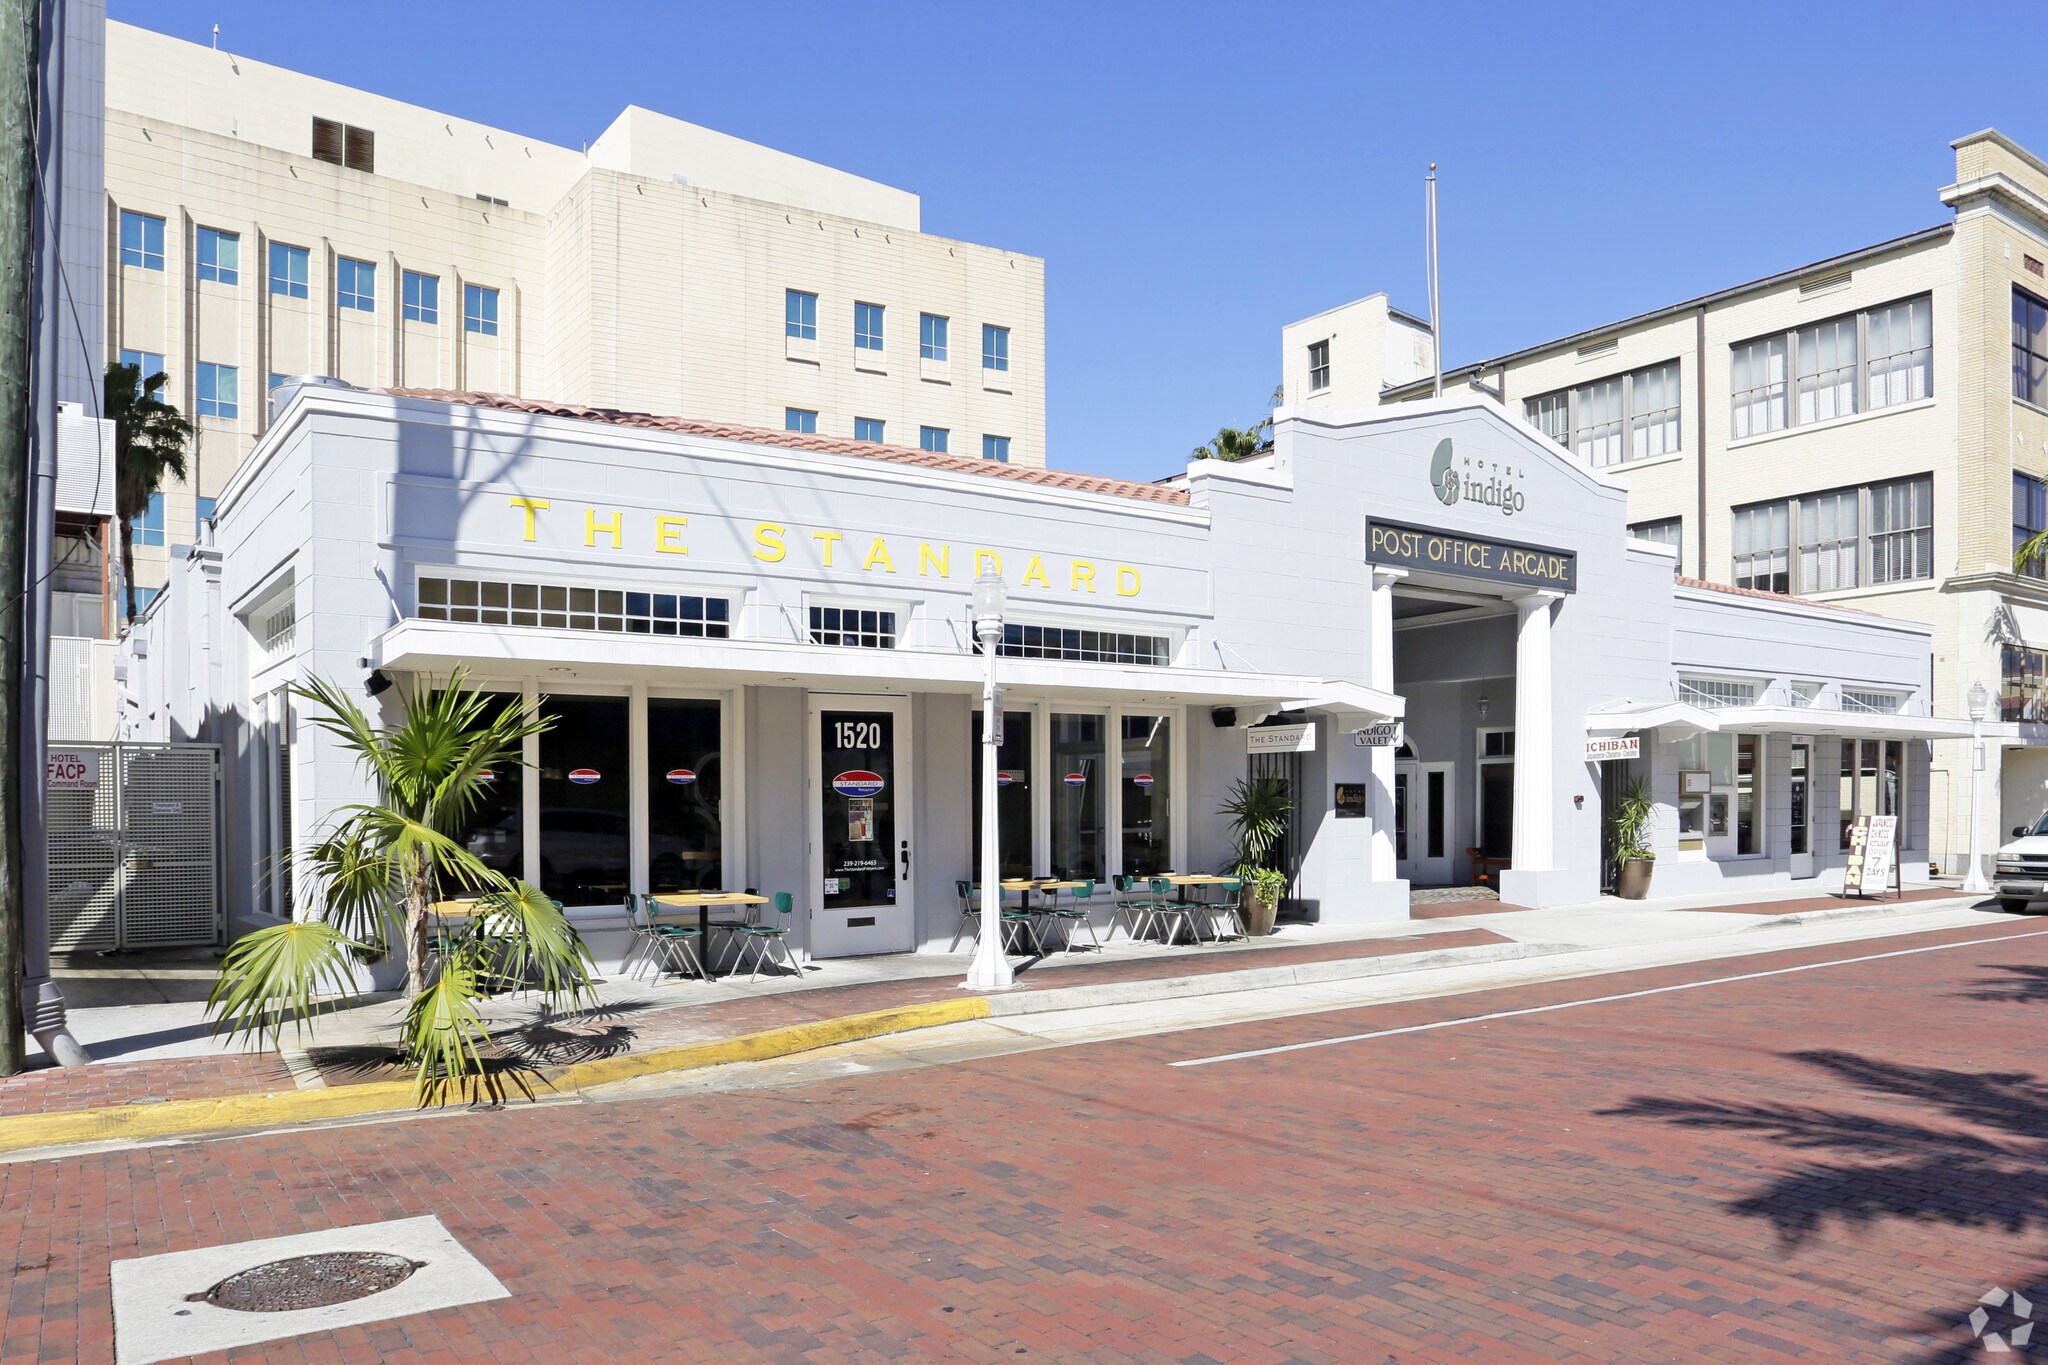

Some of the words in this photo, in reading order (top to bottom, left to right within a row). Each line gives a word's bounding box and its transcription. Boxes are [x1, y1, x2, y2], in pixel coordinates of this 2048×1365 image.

[1464, 457, 1524, 478] HOTEL
[1463, 472, 1525, 516] indigo
[510, 497, 688, 555] THE
[753, 522, 1142, 597] STANDARD
[1371, 528, 1423, 558] POST
[1427, 537, 1492, 569] OFFICE
[1499, 550, 1569, 581] ARCADE
[835, 722, 880, 749] 1520
[1359, 736, 1389, 745] VALET
[1586, 739, 1638, 753] ICHIBAN
[50, 754, 81, 763] HOTEL
[47, 763, 86, 780] FACP
[47, 779, 79, 788] Command
[79, 780, 98, 788] Room
[1869, 848, 1888, 856] OPEN
[1872, 857, 1881, 867] 7
[1866, 868, 1886, 876] DAYS
